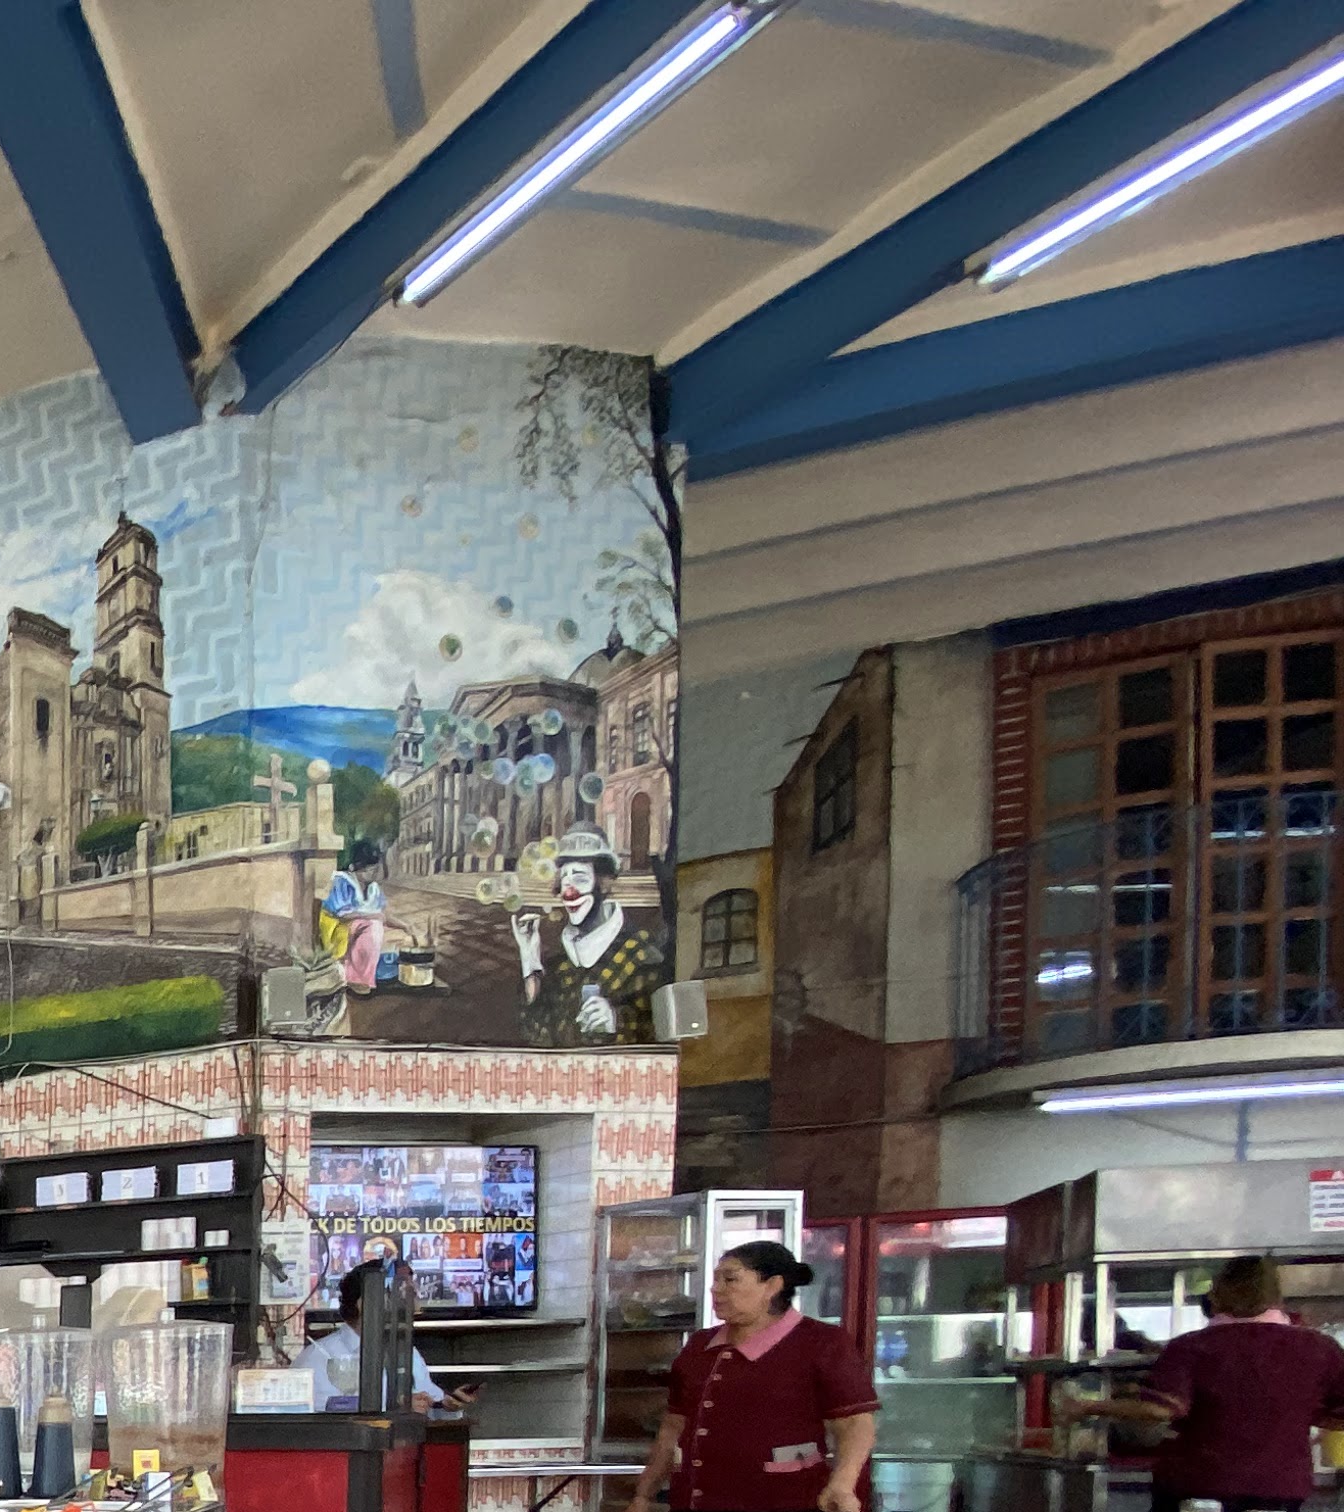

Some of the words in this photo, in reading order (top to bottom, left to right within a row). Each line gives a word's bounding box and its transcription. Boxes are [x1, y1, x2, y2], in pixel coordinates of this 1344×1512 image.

[122, 1176, 133, 1190] 2
[196, 1171, 206, 1185] 1
[333, 1216, 356, 1233] DE
[362, 1216, 421, 1233] TODOS
[425, 1216, 456, 1233] LOS
[460, 1216, 535, 1233] TIEMPOS
